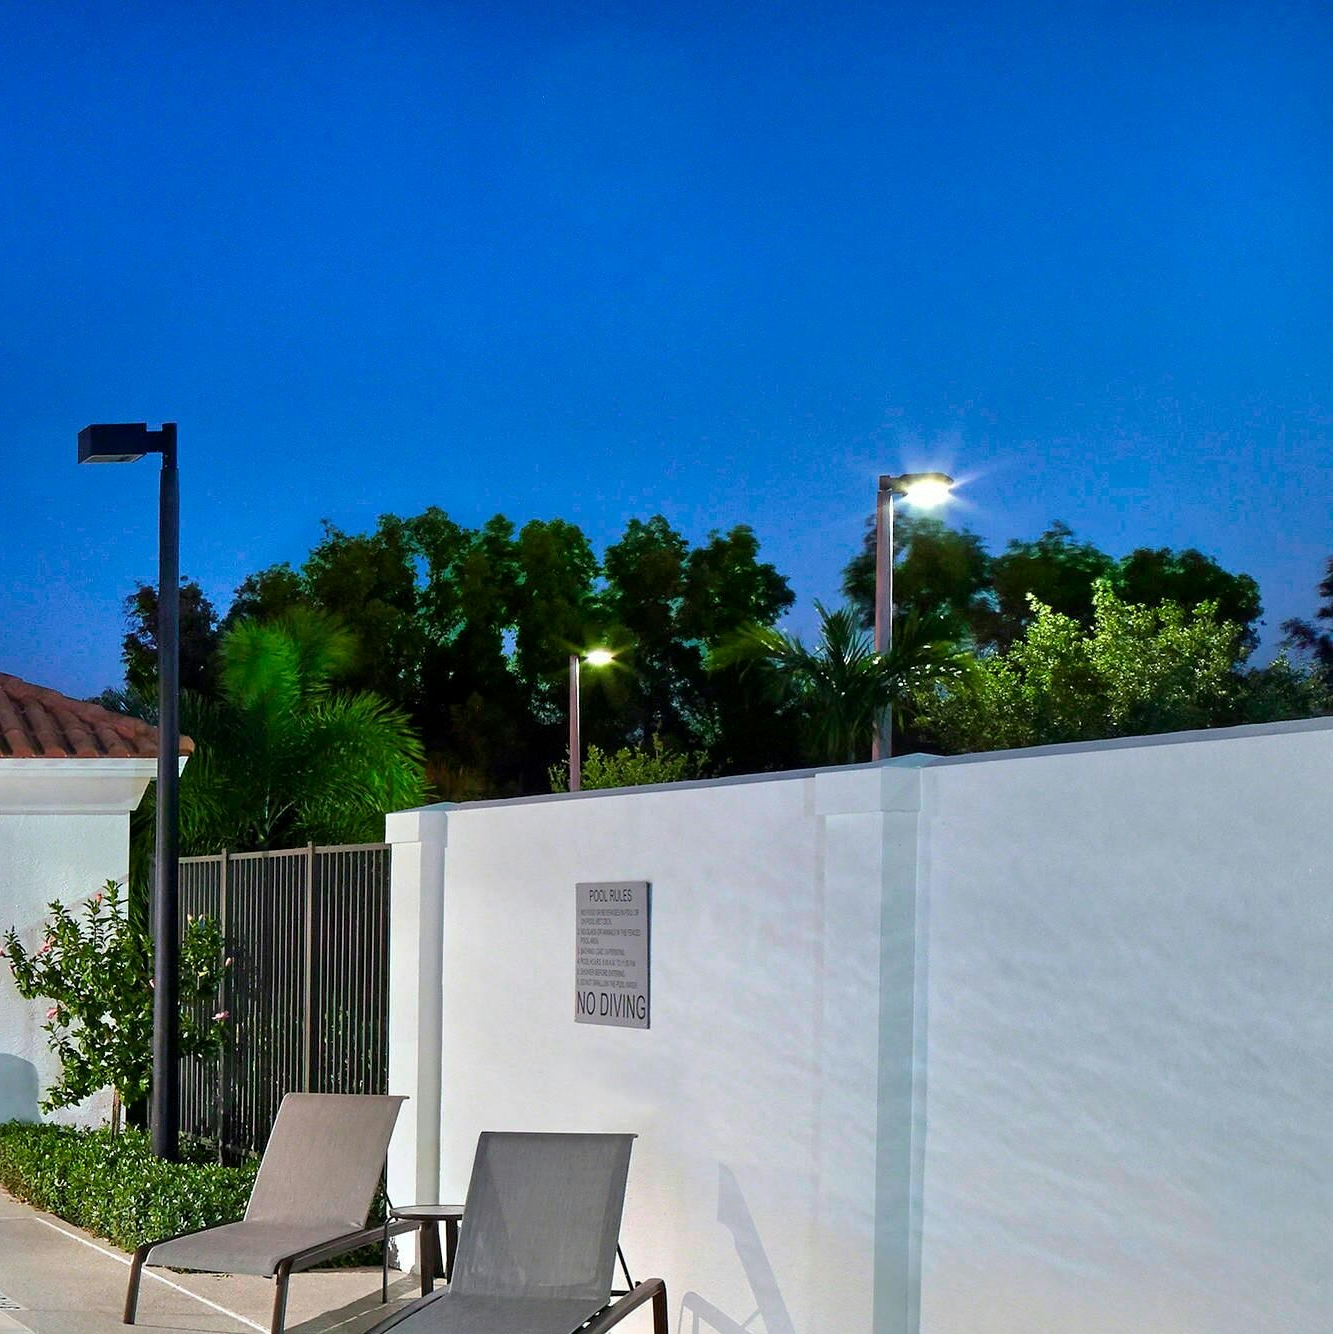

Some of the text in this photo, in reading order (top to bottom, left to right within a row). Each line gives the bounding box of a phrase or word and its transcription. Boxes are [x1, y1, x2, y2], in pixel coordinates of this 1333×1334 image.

[589, 888, 633, 902] POOL RULES
[577, 991, 646, 1020] NO DIVING
